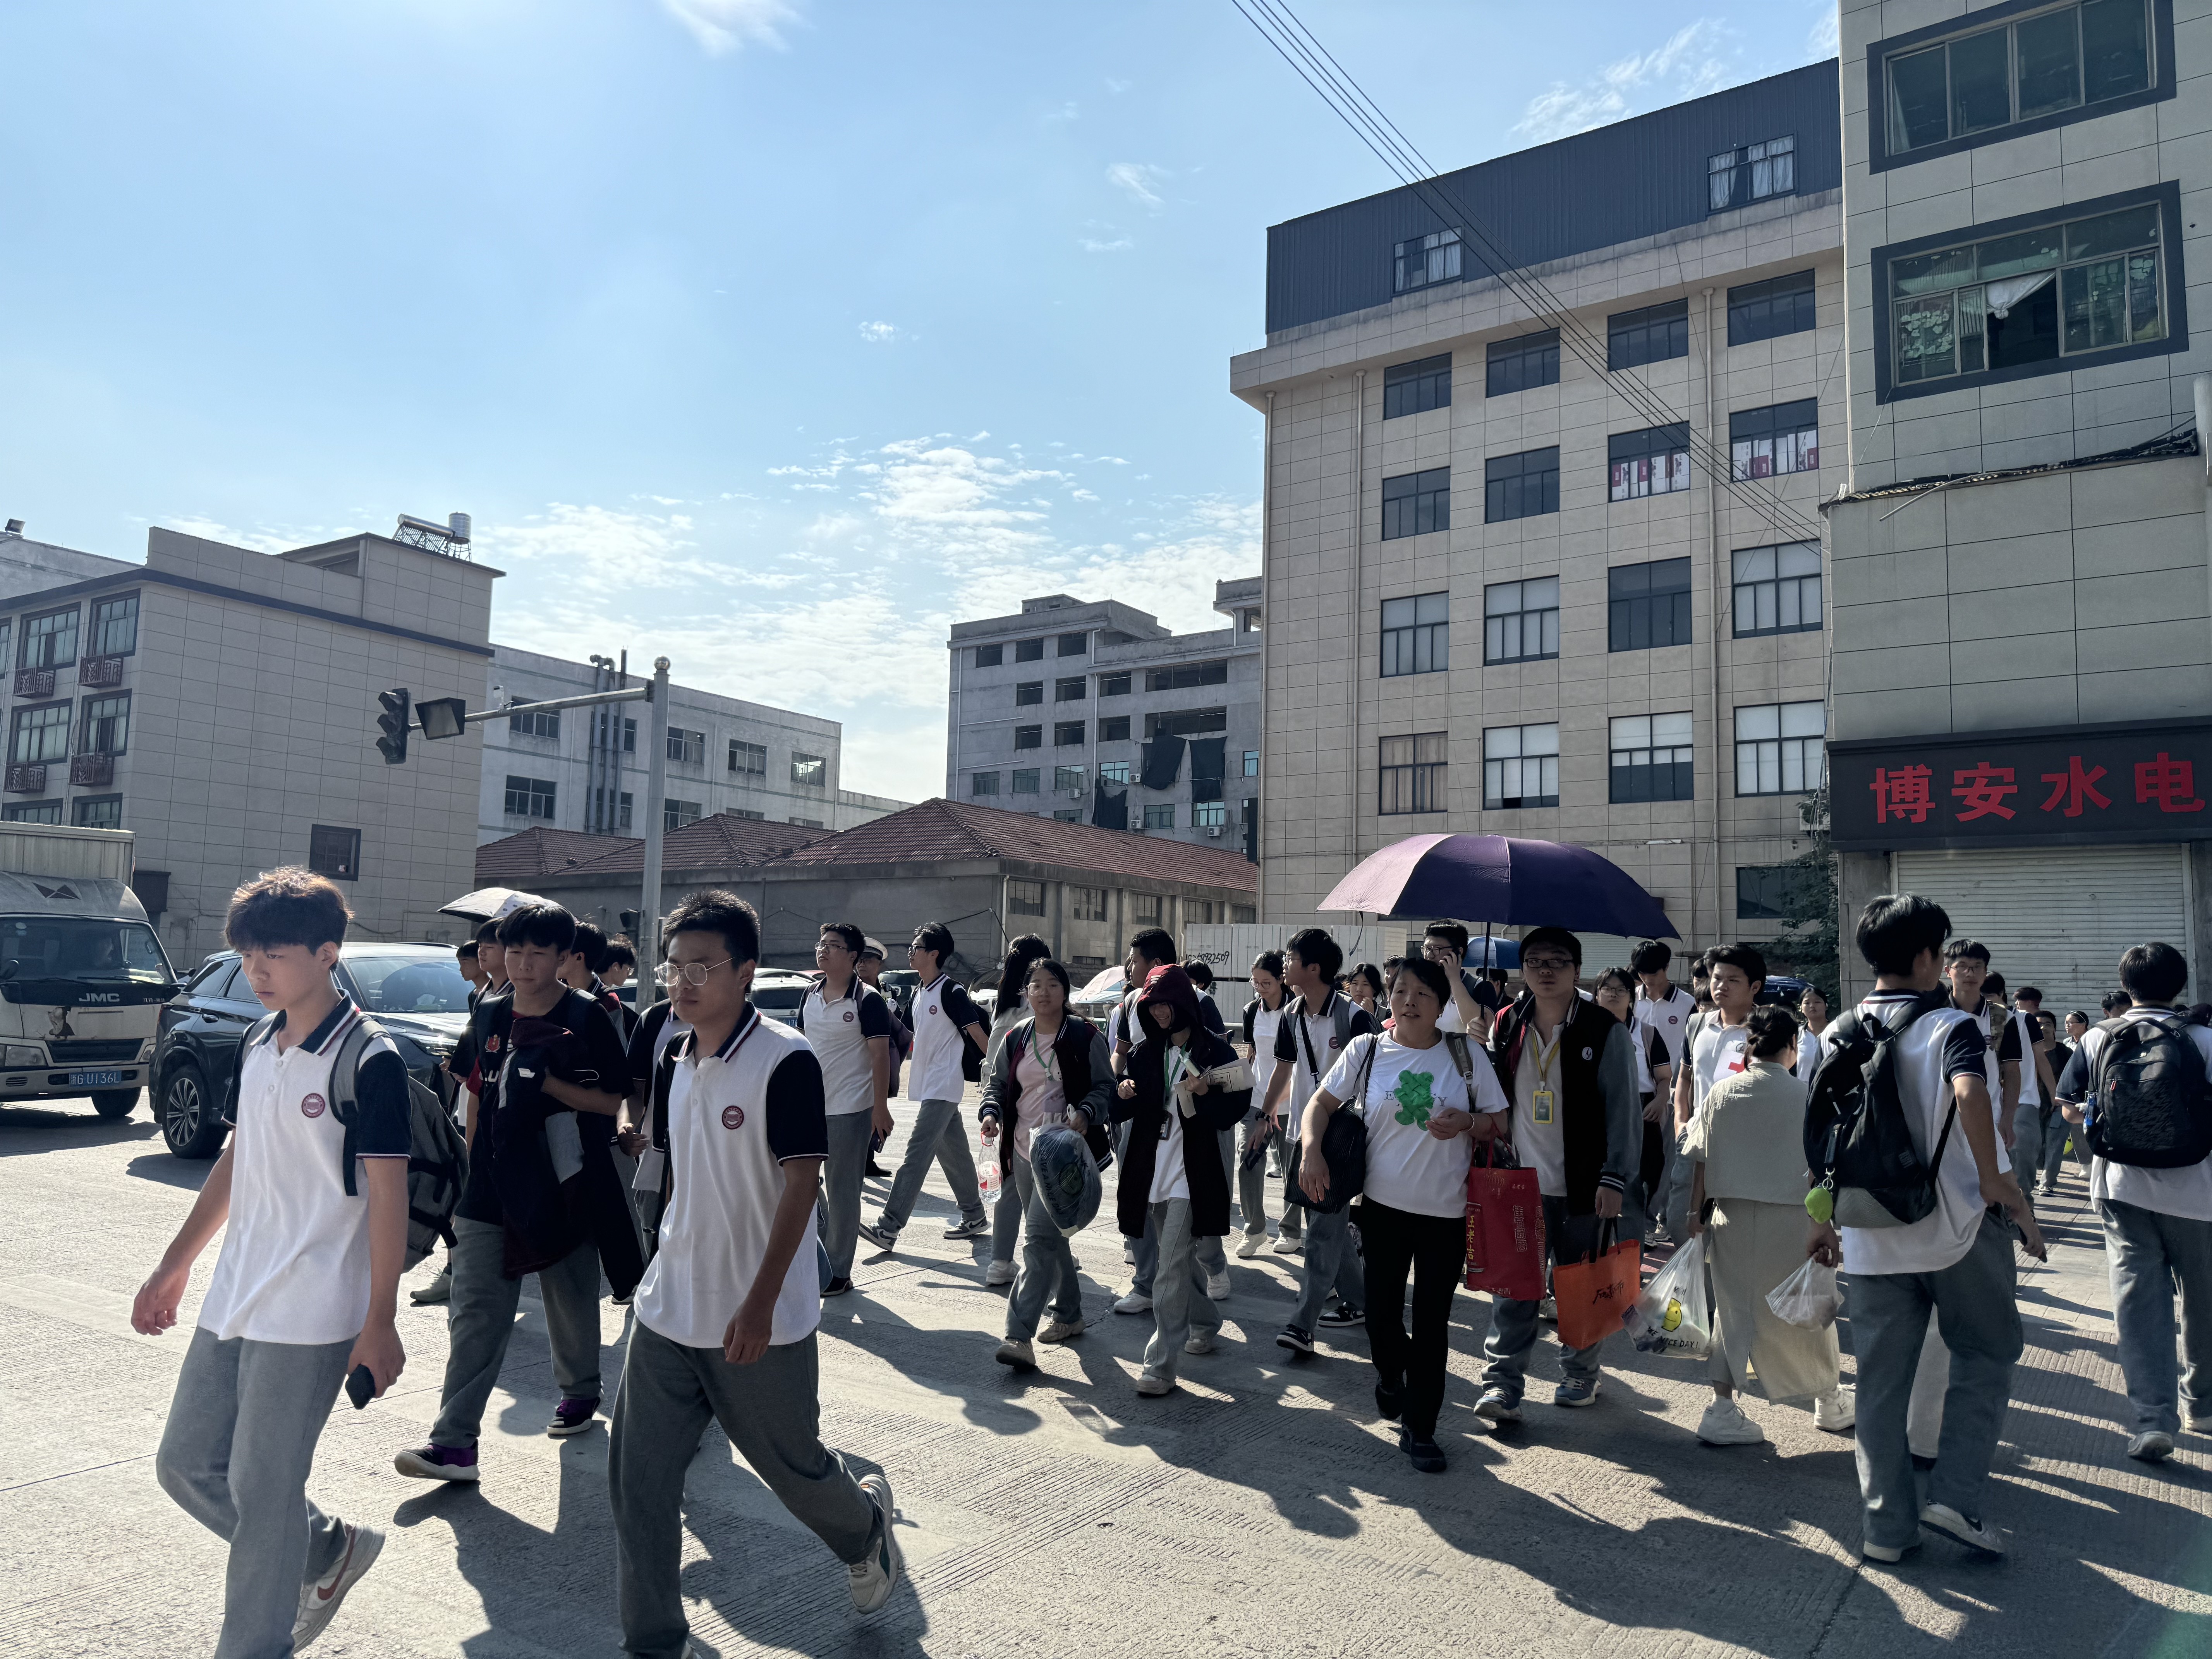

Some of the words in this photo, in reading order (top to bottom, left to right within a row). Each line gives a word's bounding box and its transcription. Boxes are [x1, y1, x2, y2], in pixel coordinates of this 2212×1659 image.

[1870, 752, 2205, 823] 博安水电
[79, 993, 120, 1002] JMC
[1467, 1215, 1475, 1260] 王老吉
